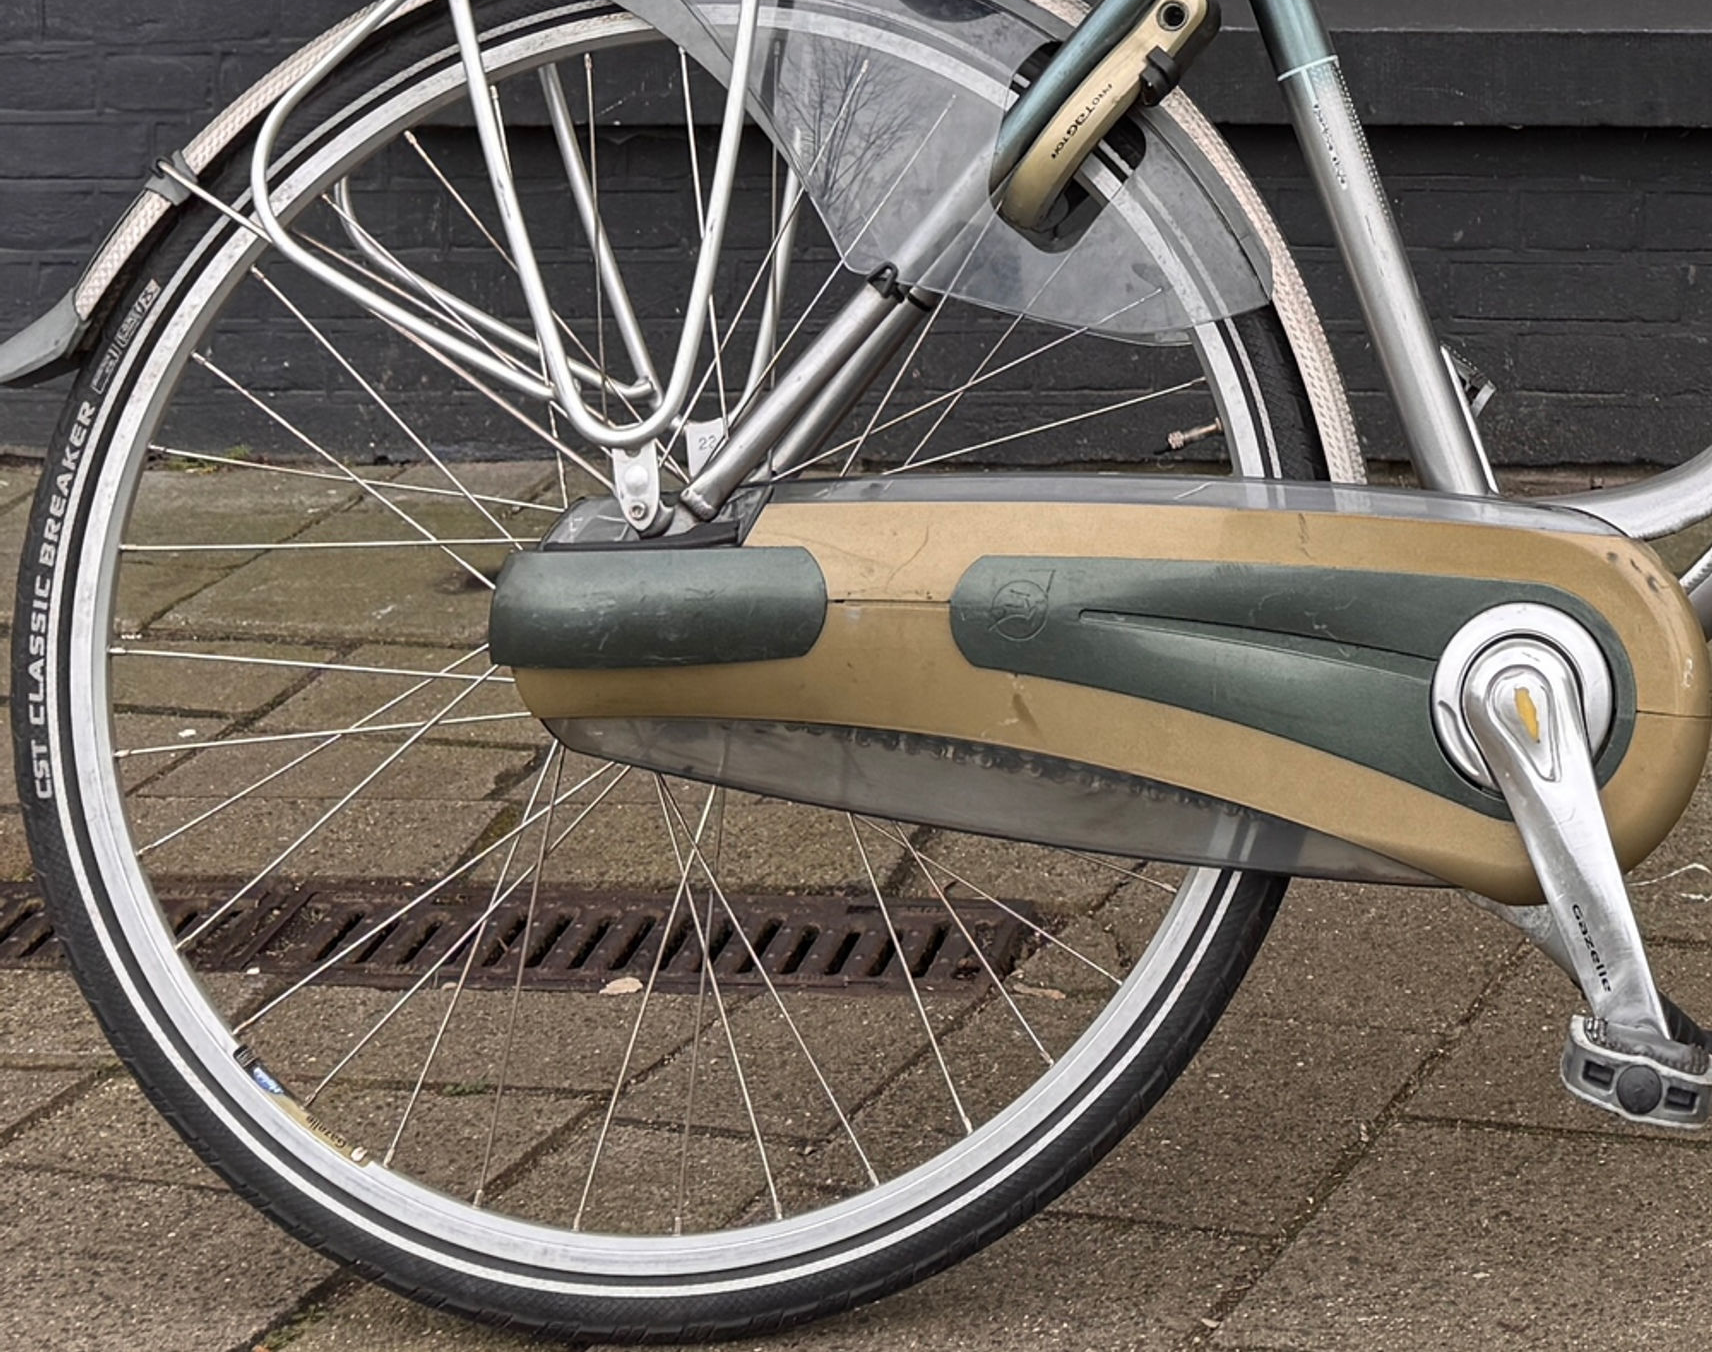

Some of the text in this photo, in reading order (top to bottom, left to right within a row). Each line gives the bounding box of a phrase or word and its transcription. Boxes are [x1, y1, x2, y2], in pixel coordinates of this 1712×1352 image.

[28, 400, 97, 799] CST CLASSIC BREAKER
[1572, 904, 1612, 992] Gazelle
